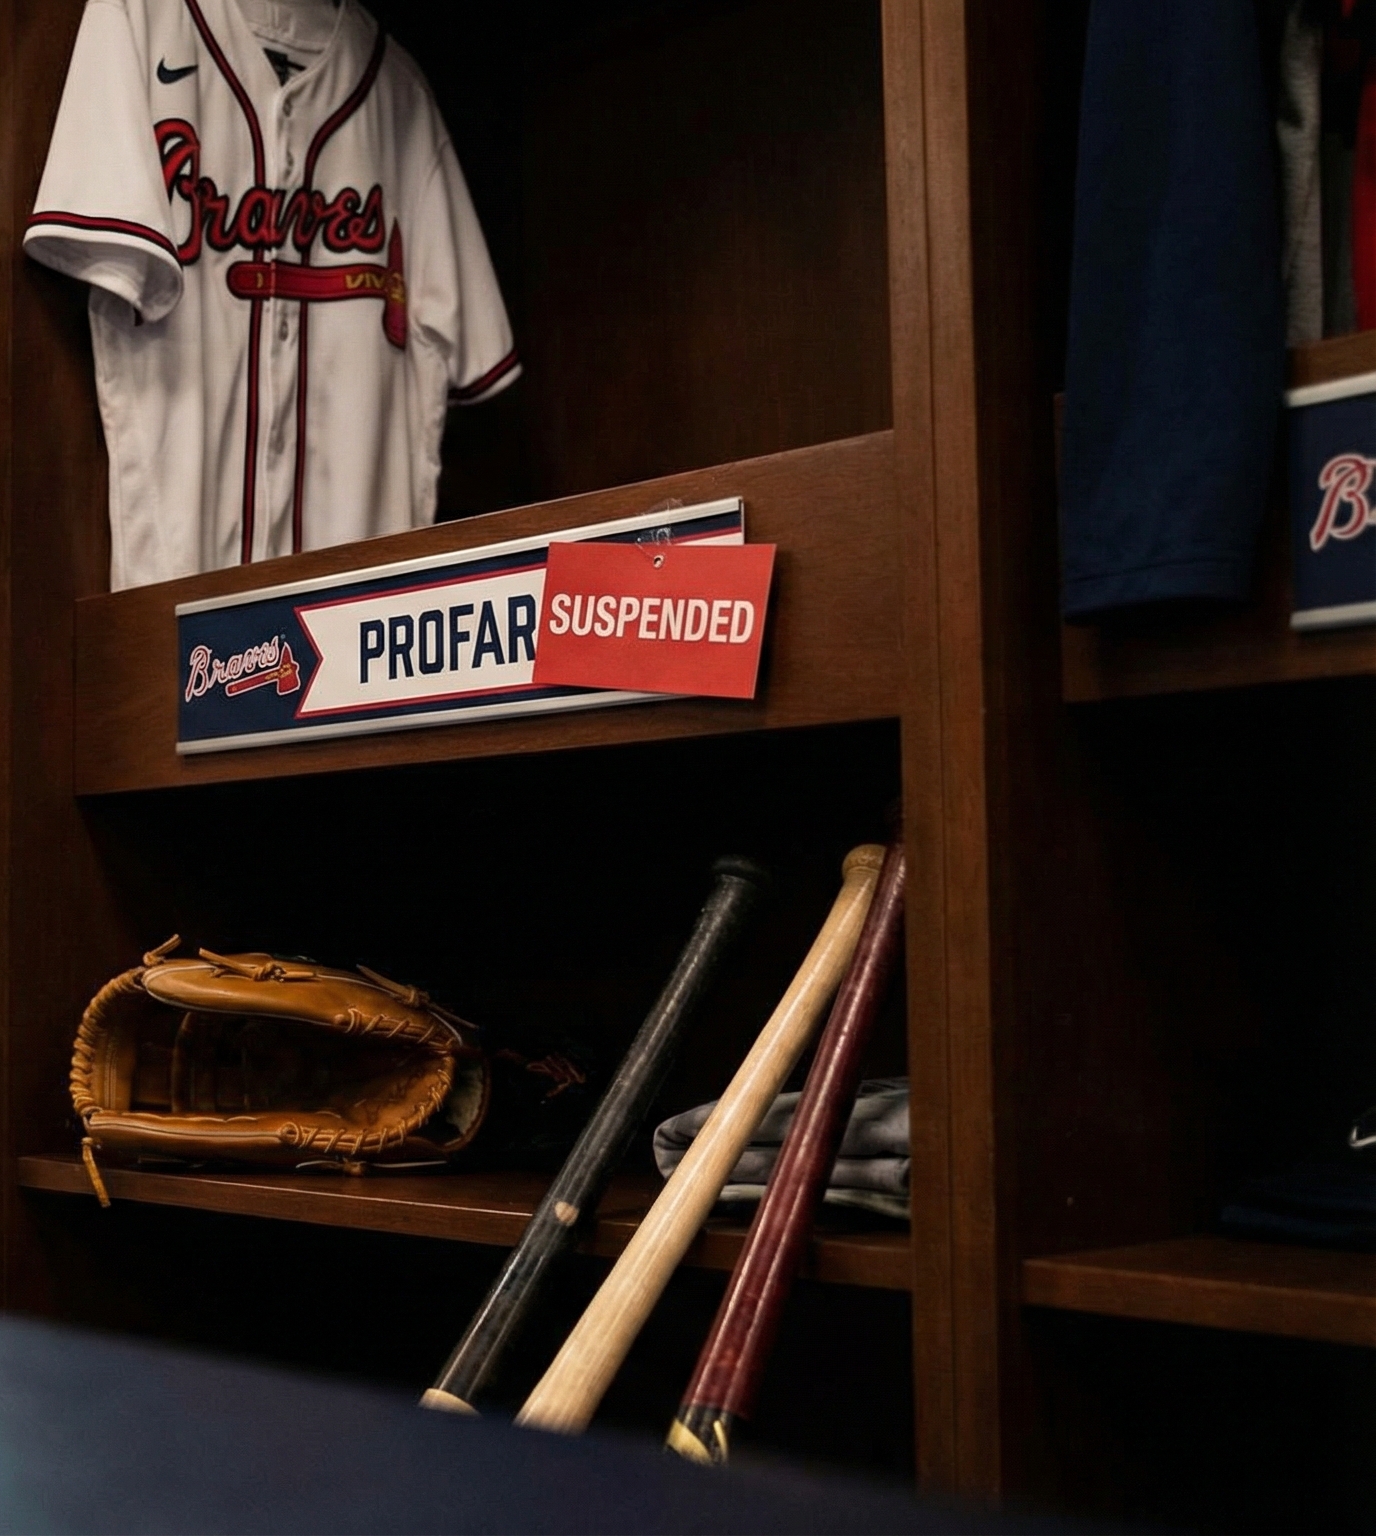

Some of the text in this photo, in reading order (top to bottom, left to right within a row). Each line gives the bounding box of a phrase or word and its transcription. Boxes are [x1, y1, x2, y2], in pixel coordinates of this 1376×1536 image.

[154, 118, 385, 265] Braves
[359, 593, 536, 684] PROFAR
[548, 592, 755, 645] SUSPENDED
[185, 635, 280, 702] Braves
